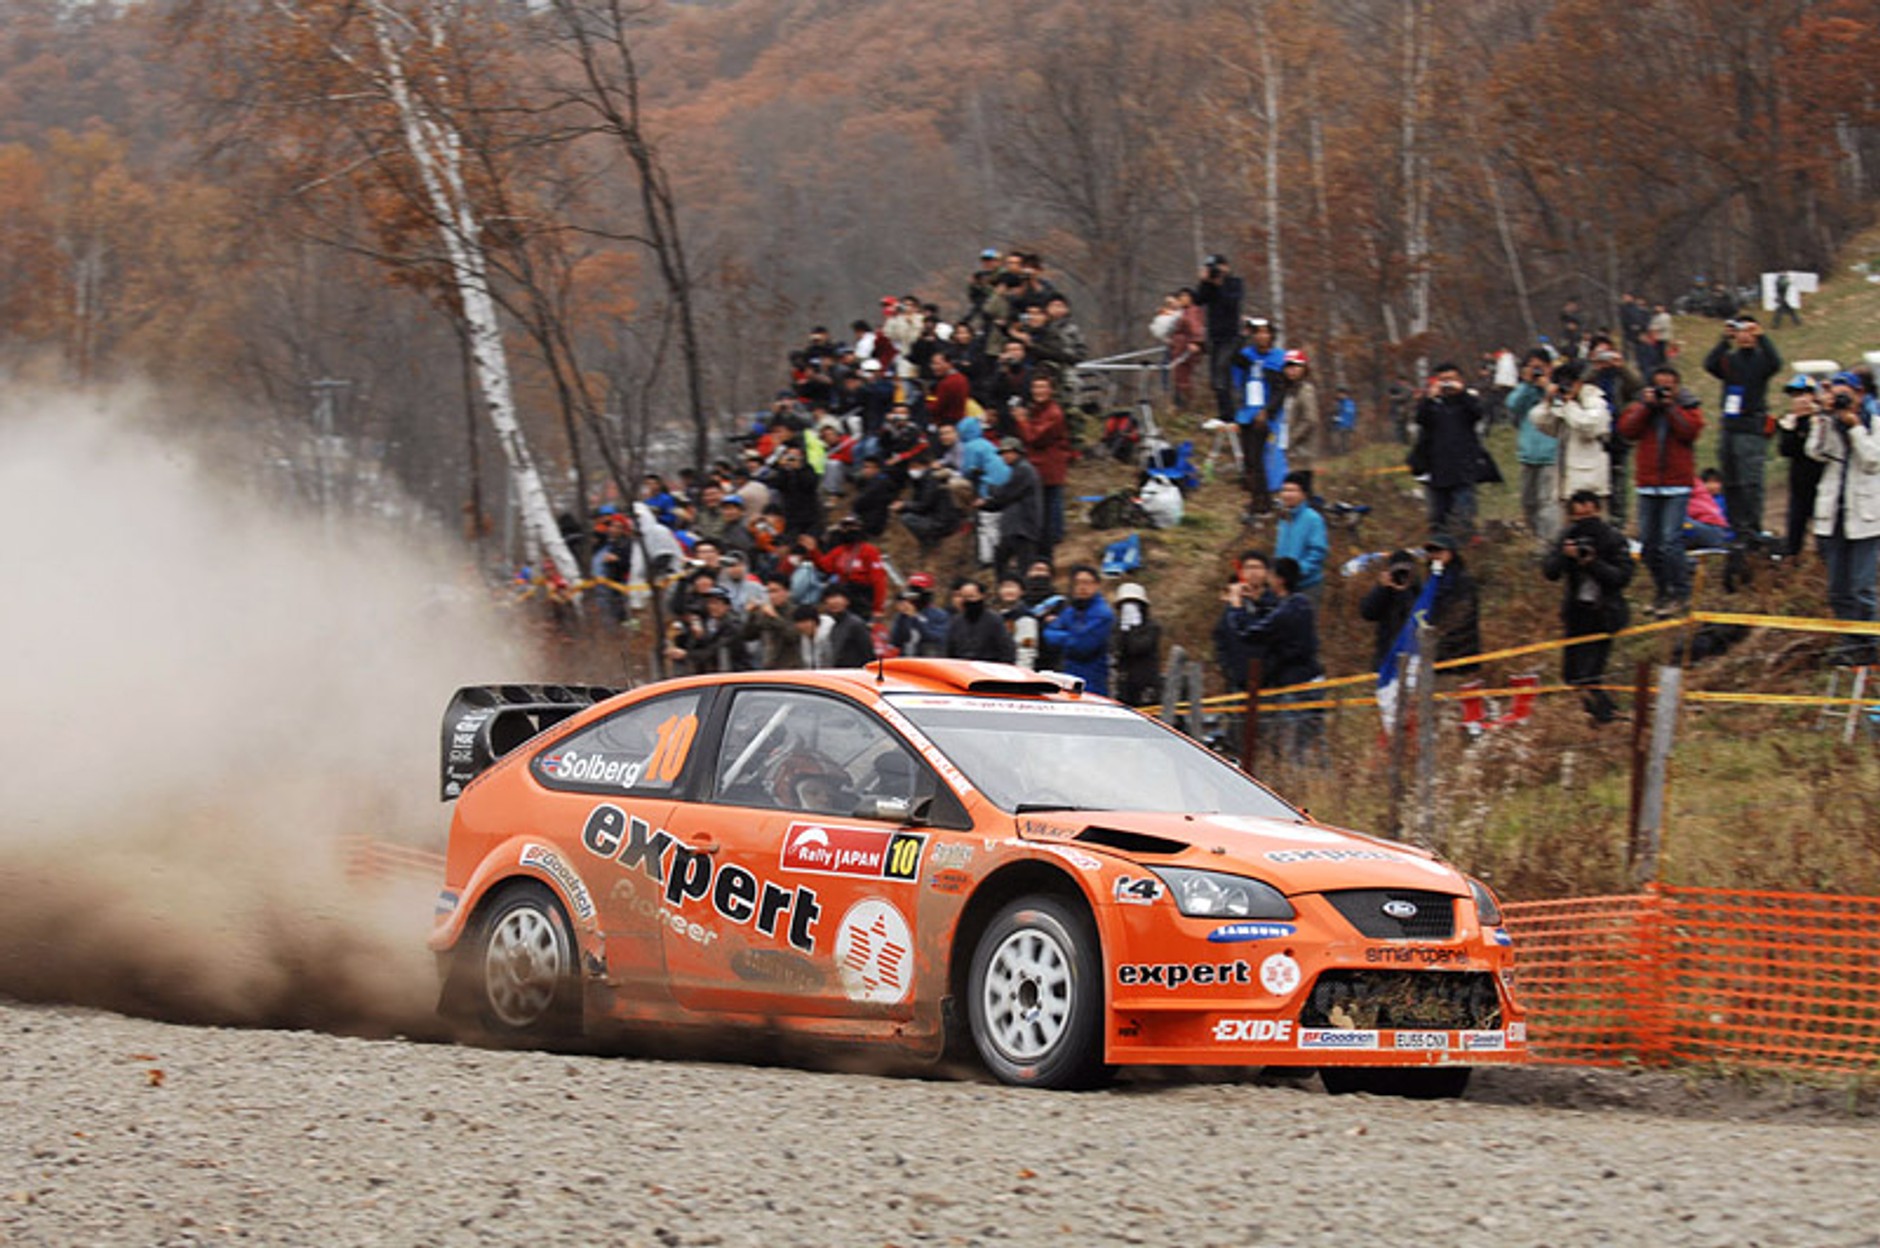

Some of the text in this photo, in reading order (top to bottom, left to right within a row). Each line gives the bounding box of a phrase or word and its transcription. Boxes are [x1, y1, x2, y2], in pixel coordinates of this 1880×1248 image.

[644, 714, 699, 782] 10
[557, 751, 641, 789] Solberg
[799, 846, 881, 871] Rally JAPAN
[890, 839, 919, 876] 10
[581, 803, 821, 954] expert
[1216, 925, 1290, 936] SAMSUNG
[1118, 960, 1250, 989] expert
[1212, 1019, 1293, 1042] EXIDE
